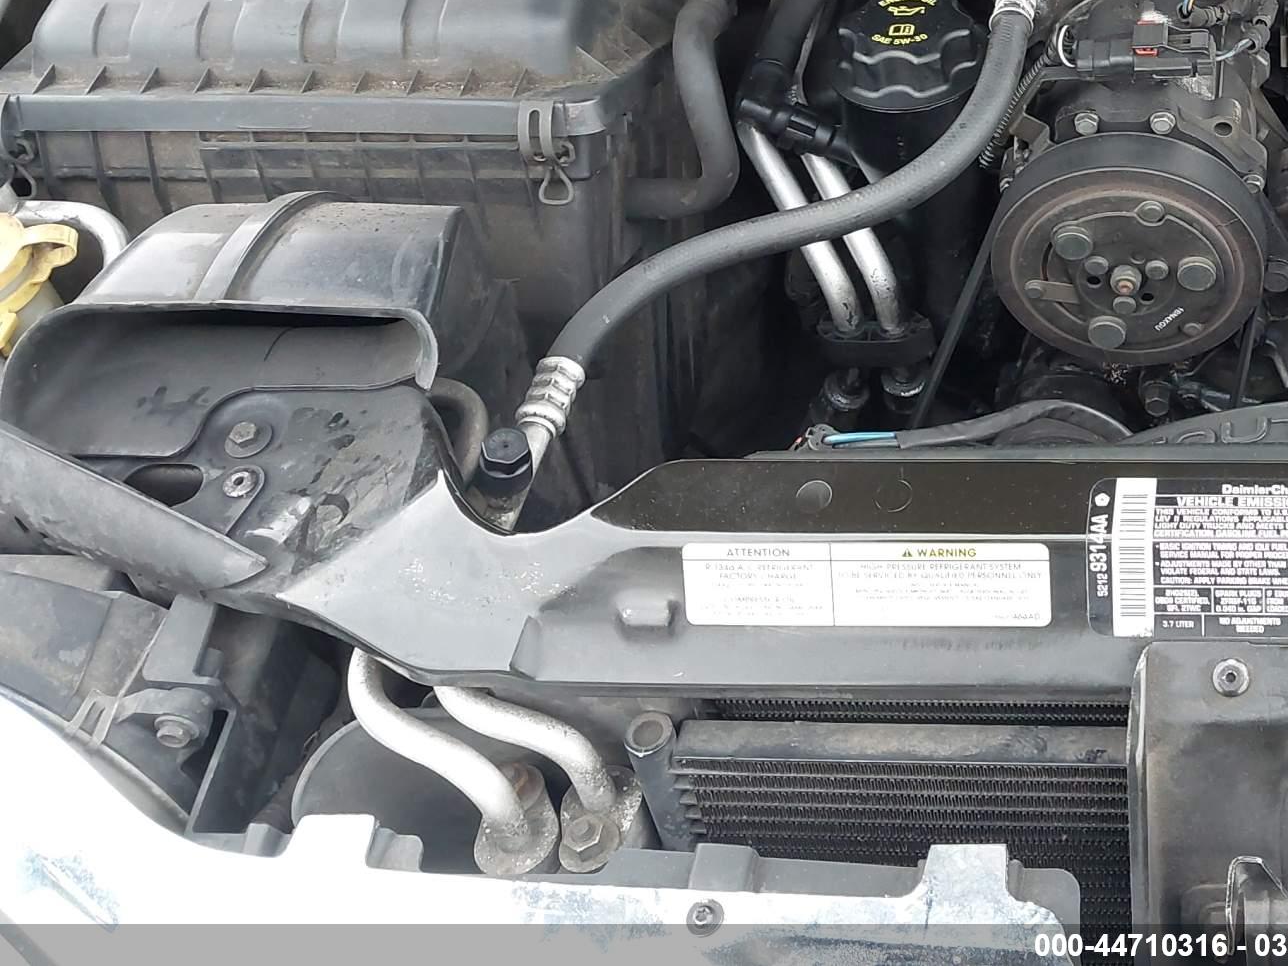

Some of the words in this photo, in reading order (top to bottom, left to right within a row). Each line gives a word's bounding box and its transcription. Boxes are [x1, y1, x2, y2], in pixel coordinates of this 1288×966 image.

[871, 34, 893, 44] SAE
[892, 34, 929, 45] 5W-30
[1177, 496, 1233, 507] VEHICLE
[727, 548, 790, 557] ATTENTION
[917, 548, 977, 558] WARNING
[988, 563, 1021, 571] SYSTEM
[1162, 620, 1174, 628] 3.7
[1175, 620, 1195, 628] LITER
